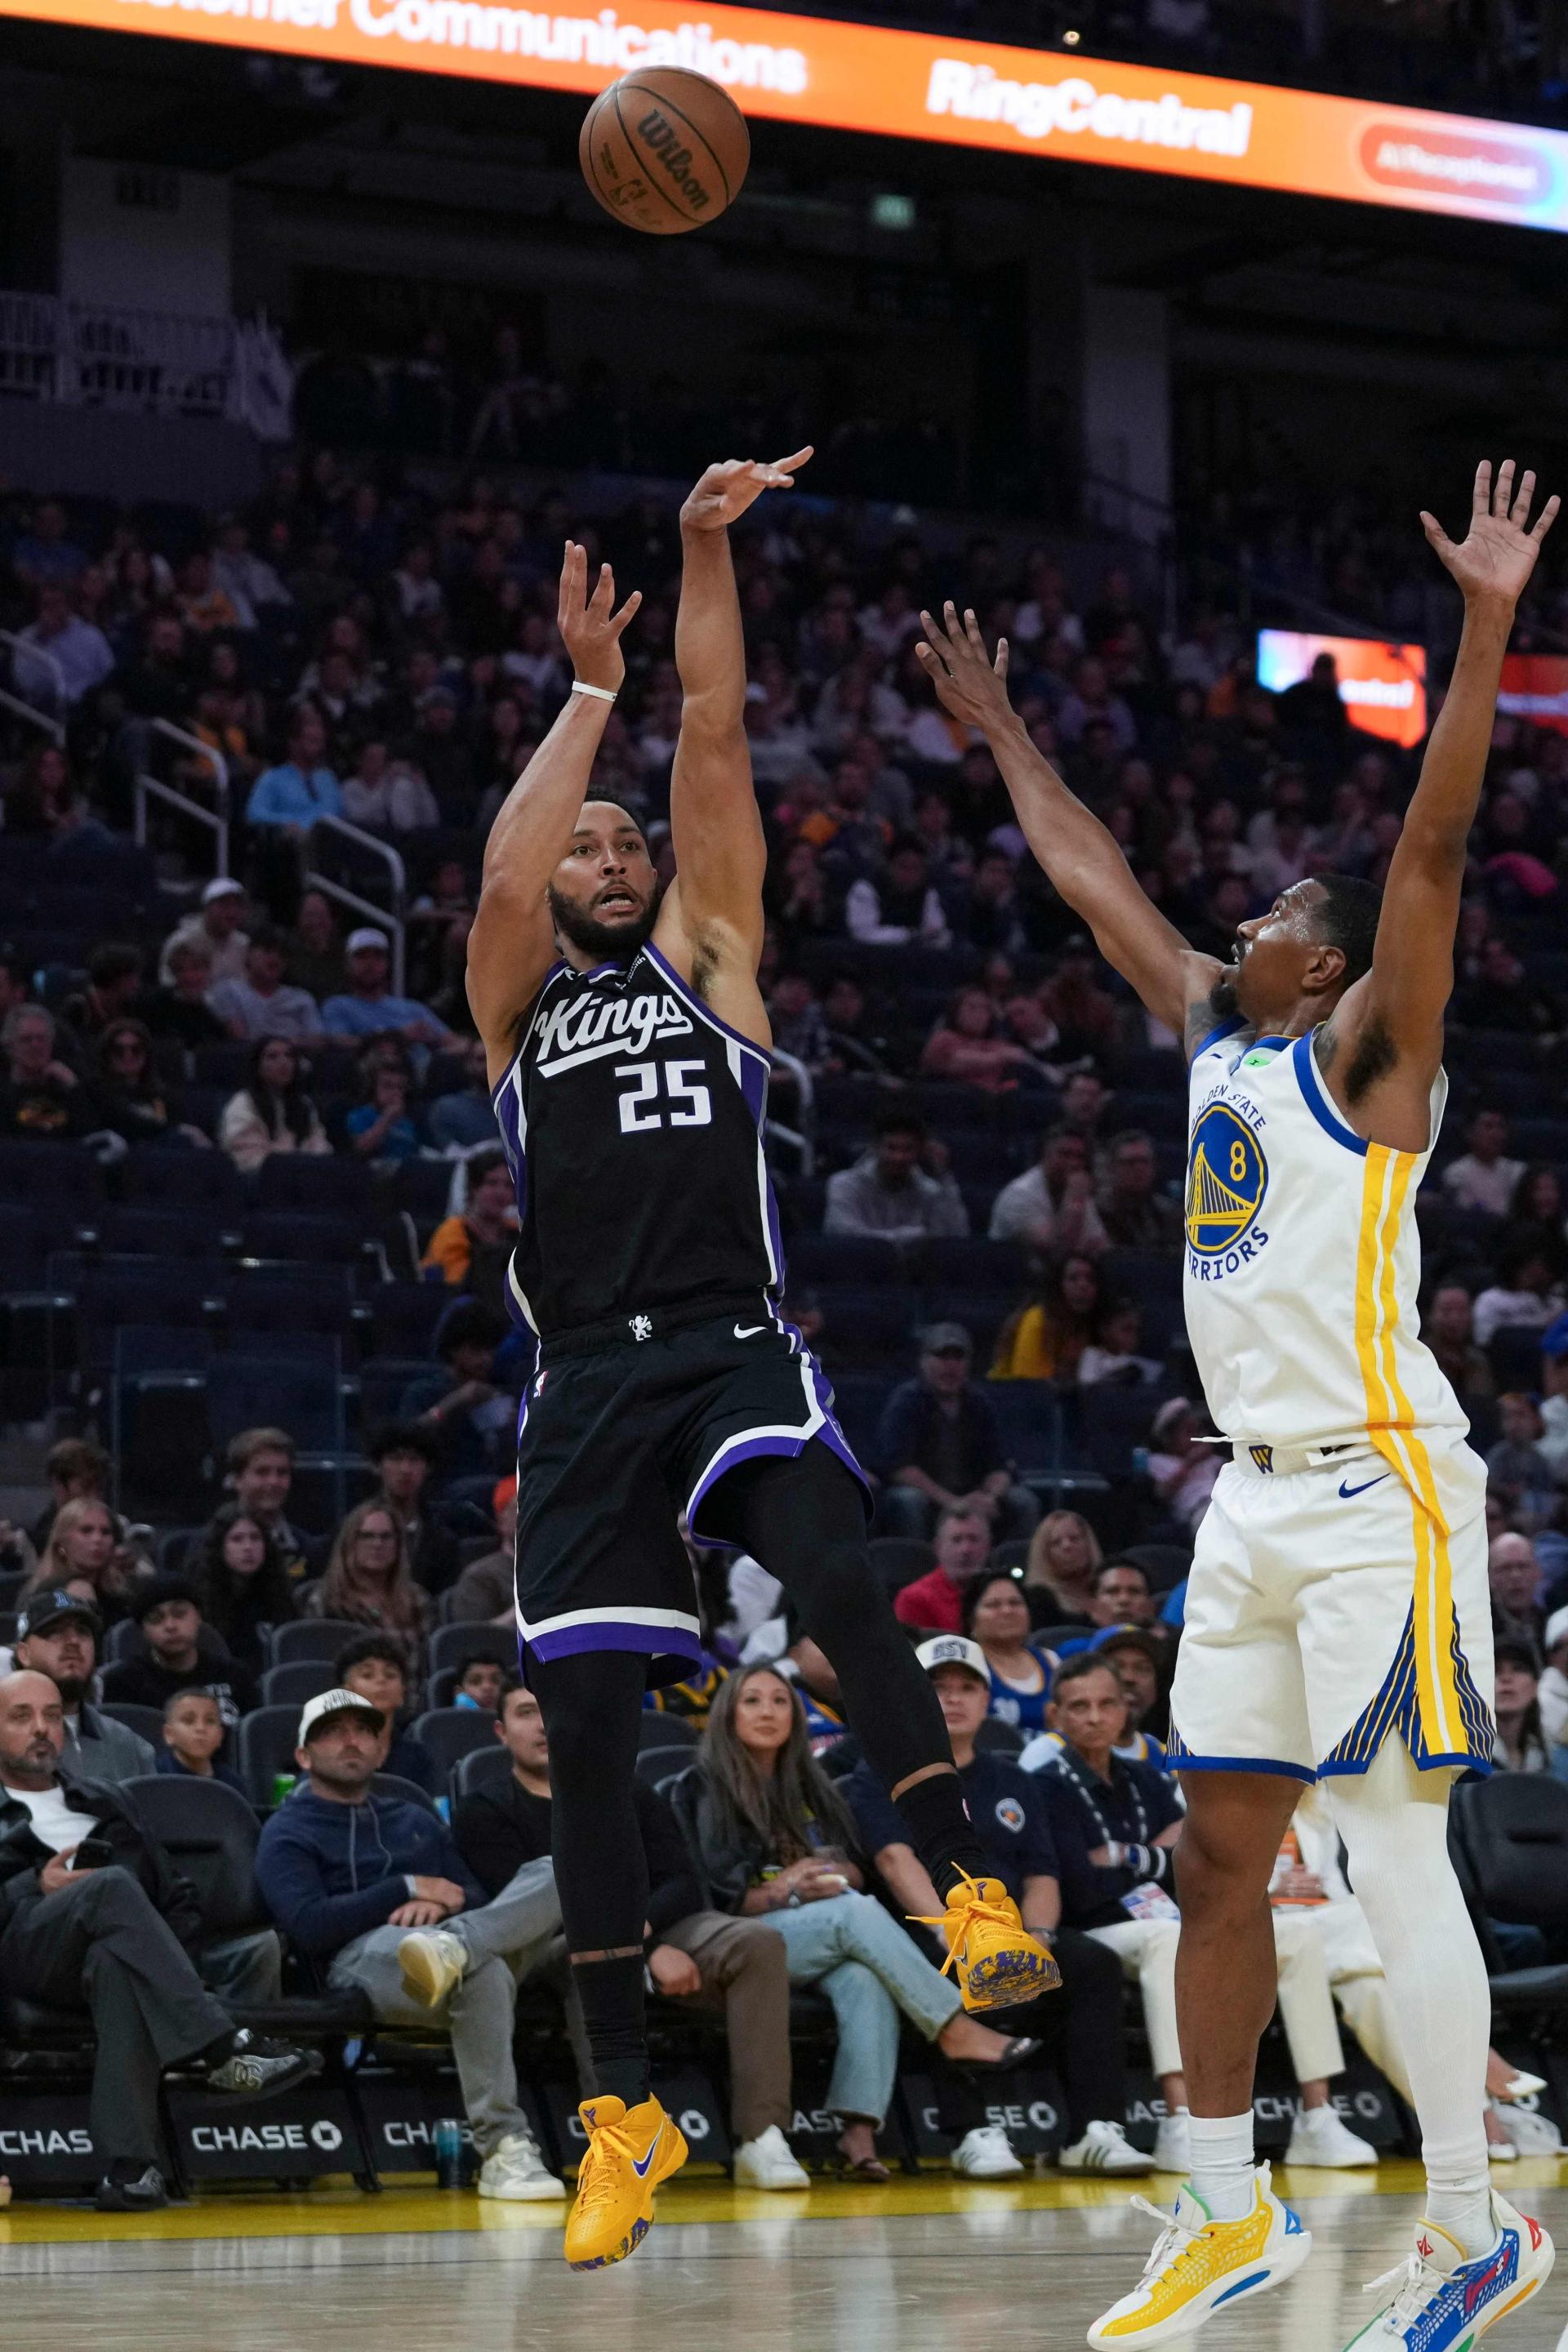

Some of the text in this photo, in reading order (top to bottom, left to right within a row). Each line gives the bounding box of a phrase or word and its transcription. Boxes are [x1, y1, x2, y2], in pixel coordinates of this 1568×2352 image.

[351, 0, 808, 96] Communications
[926, 57, 1254, 158] RingCentral
[637, 109, 710, 211] Wilson
[535, 991, 693, 1078] Kings
[614, 1059, 712, 1134] 25
[1227, 1094, 1267, 1132] STATE
[1230, 1141, 1246, 1181] 8
[1189, 1226, 1269, 1281] RRIORS
[922, 2105, 1028, 2130] CSE
[1254, 2095, 1353, 2121] CHE
[0, 2128, 94, 2156] CHAS
[191, 2125, 309, 2151] CHASE
